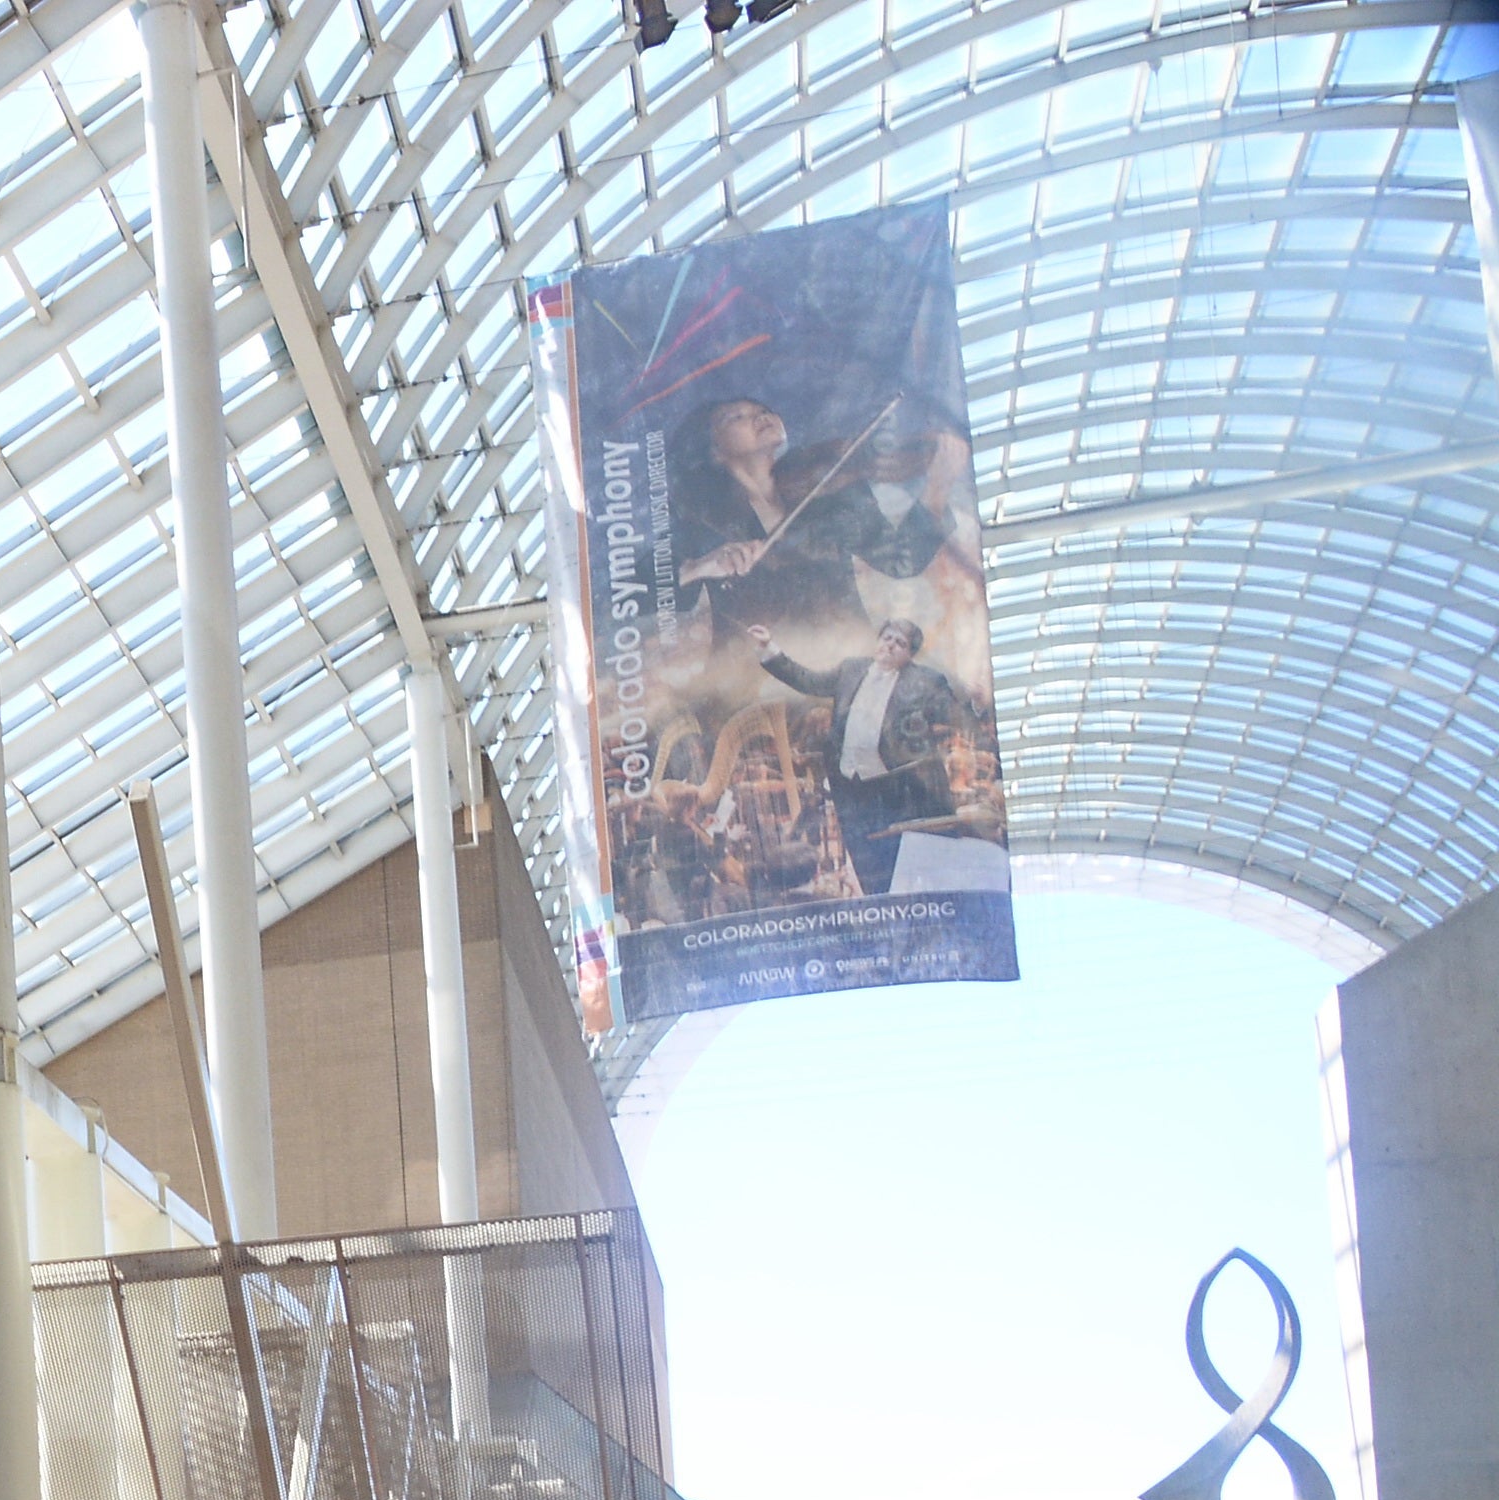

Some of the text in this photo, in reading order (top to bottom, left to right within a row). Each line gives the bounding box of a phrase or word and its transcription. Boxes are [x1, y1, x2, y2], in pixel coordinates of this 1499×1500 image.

[596, 440, 652, 800] colorado symphony
[645, 430, 679, 645] ANDREW LITTON, MUSIC DIRECTOR
[682, 901, 956, 950] COLORADOSYMPHONY.ORG
